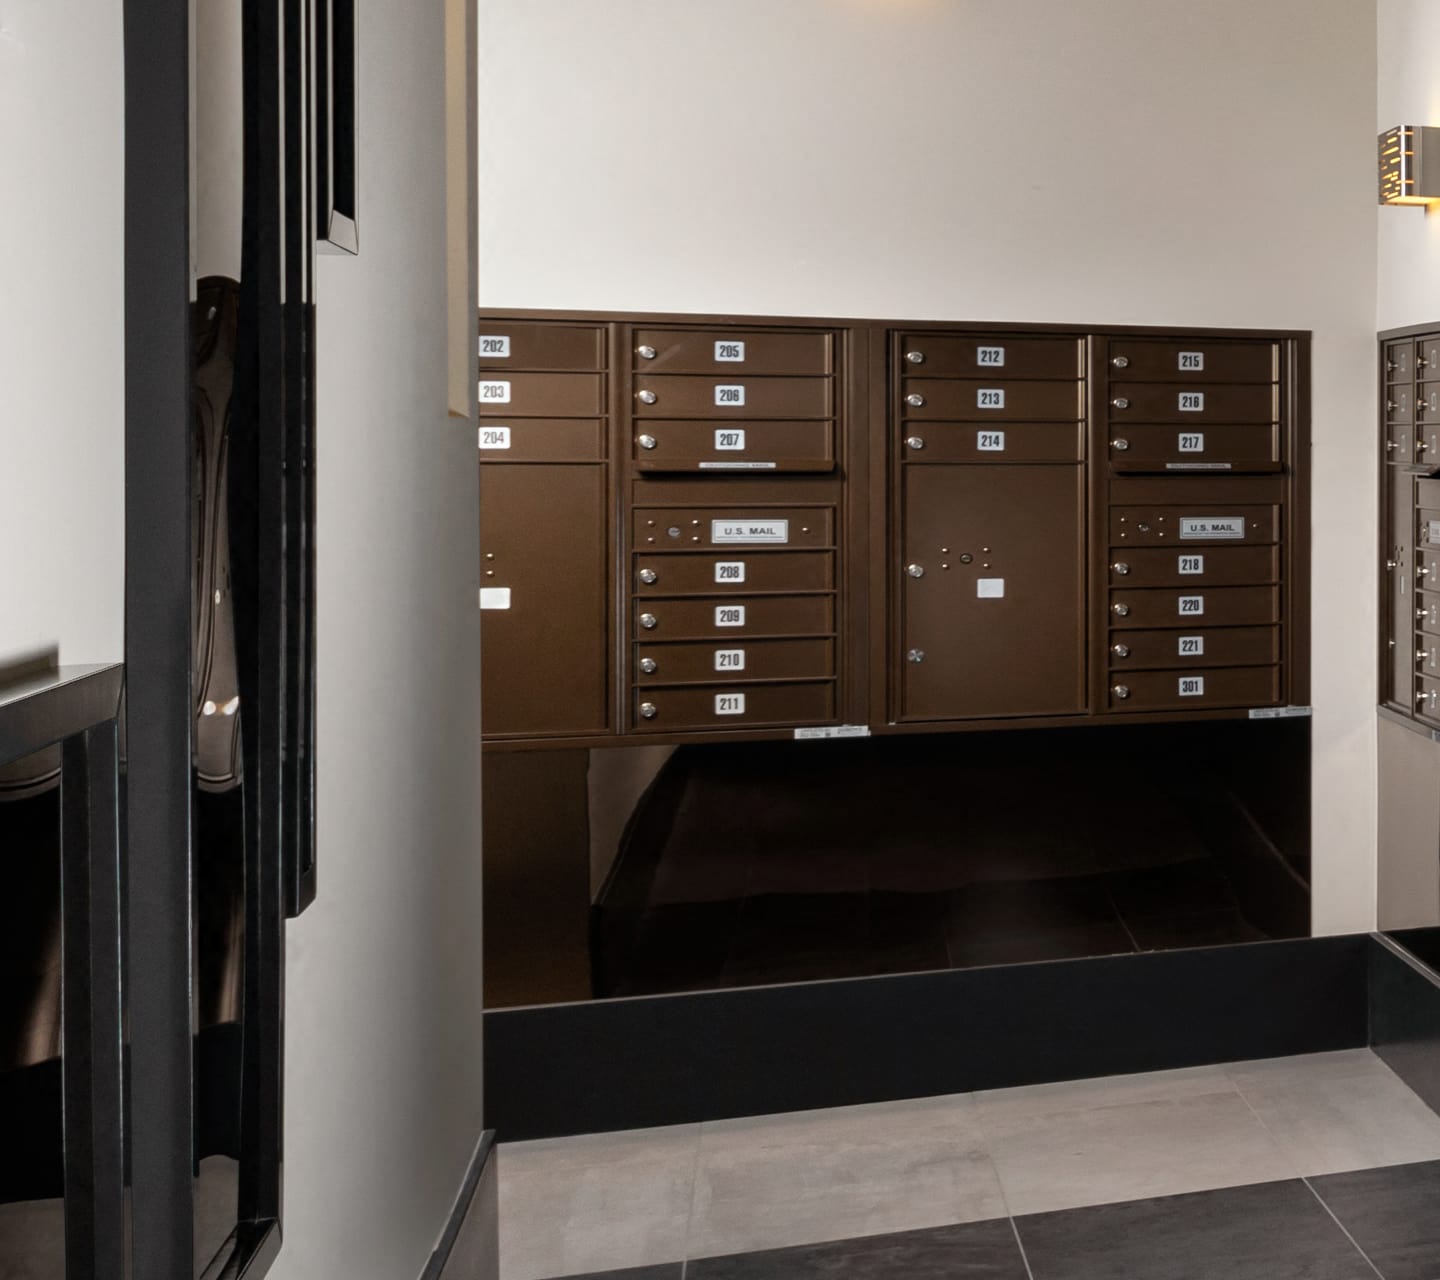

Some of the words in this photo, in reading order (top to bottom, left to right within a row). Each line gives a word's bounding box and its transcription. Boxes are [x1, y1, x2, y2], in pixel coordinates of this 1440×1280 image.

[482, 338, 505, 353] 202
[719, 344, 740, 359] 205
[980, 349, 1001, 364] 212
[1181, 354, 1200, 368] 215
[482, 384, 505, 399] 203
[719, 388, 740, 403] 206
[980, 391, 1001, 406] 213
[1181, 395, 1200, 409] 216
[483, 430, 505, 445] 204
[719, 432, 740, 447] 207
[980, 434, 1001, 448] 214
[1181, 435, 1200, 449] 217
[724, 527, 745, 535] U.S.
[749, 527, 776, 535] MAIL
[1190, 524, 1208, 532] U.S.
[1211, 524, 1235, 532] MAIL
[719, 565, 740, 579] 208
[1181, 557, 1200, 572] 218
[1181, 598, 1200, 613] 220
[719, 608, 741, 623] 209
[1181, 639, 1199, 653] 221
[719, 652, 740, 667] 210
[1181, 679, 1199, 694] 301
[719, 697, 739, 711] 211
